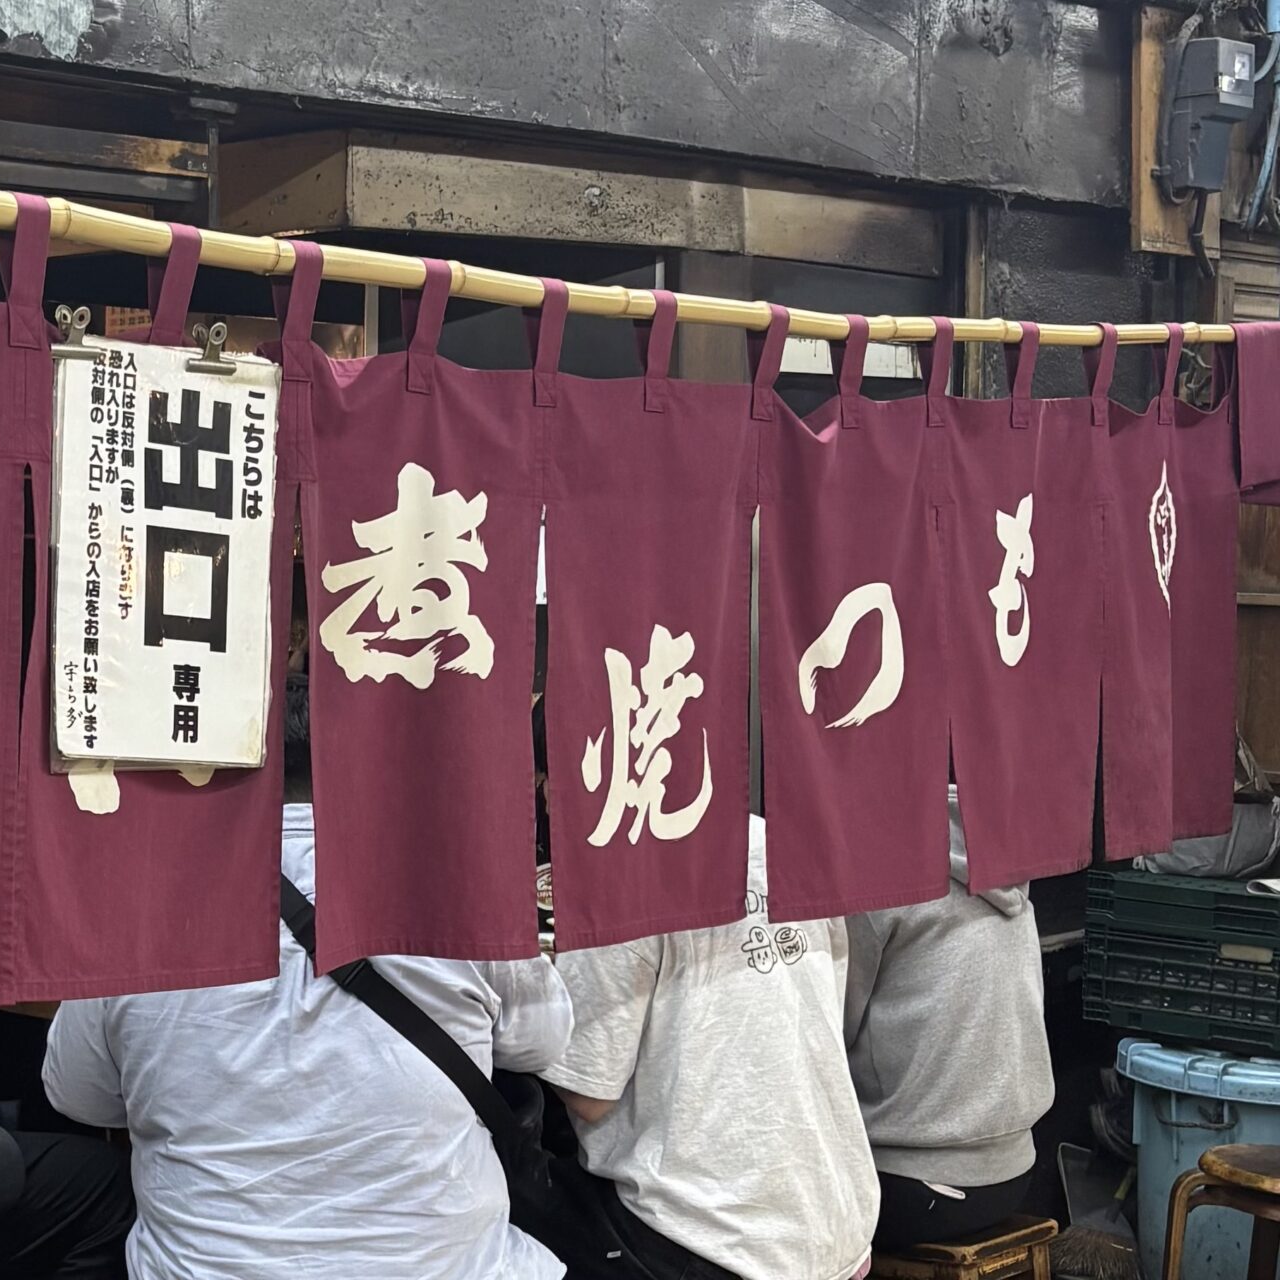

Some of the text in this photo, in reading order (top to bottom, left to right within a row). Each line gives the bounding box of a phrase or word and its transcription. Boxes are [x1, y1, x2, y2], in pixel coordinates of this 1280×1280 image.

[105, 349, 123, 484] 恐れ入りますが
[240, 390, 266, 520] こちらは
[144, 388, 234, 654] 出口
[171, 663, 201, 744] 専用
